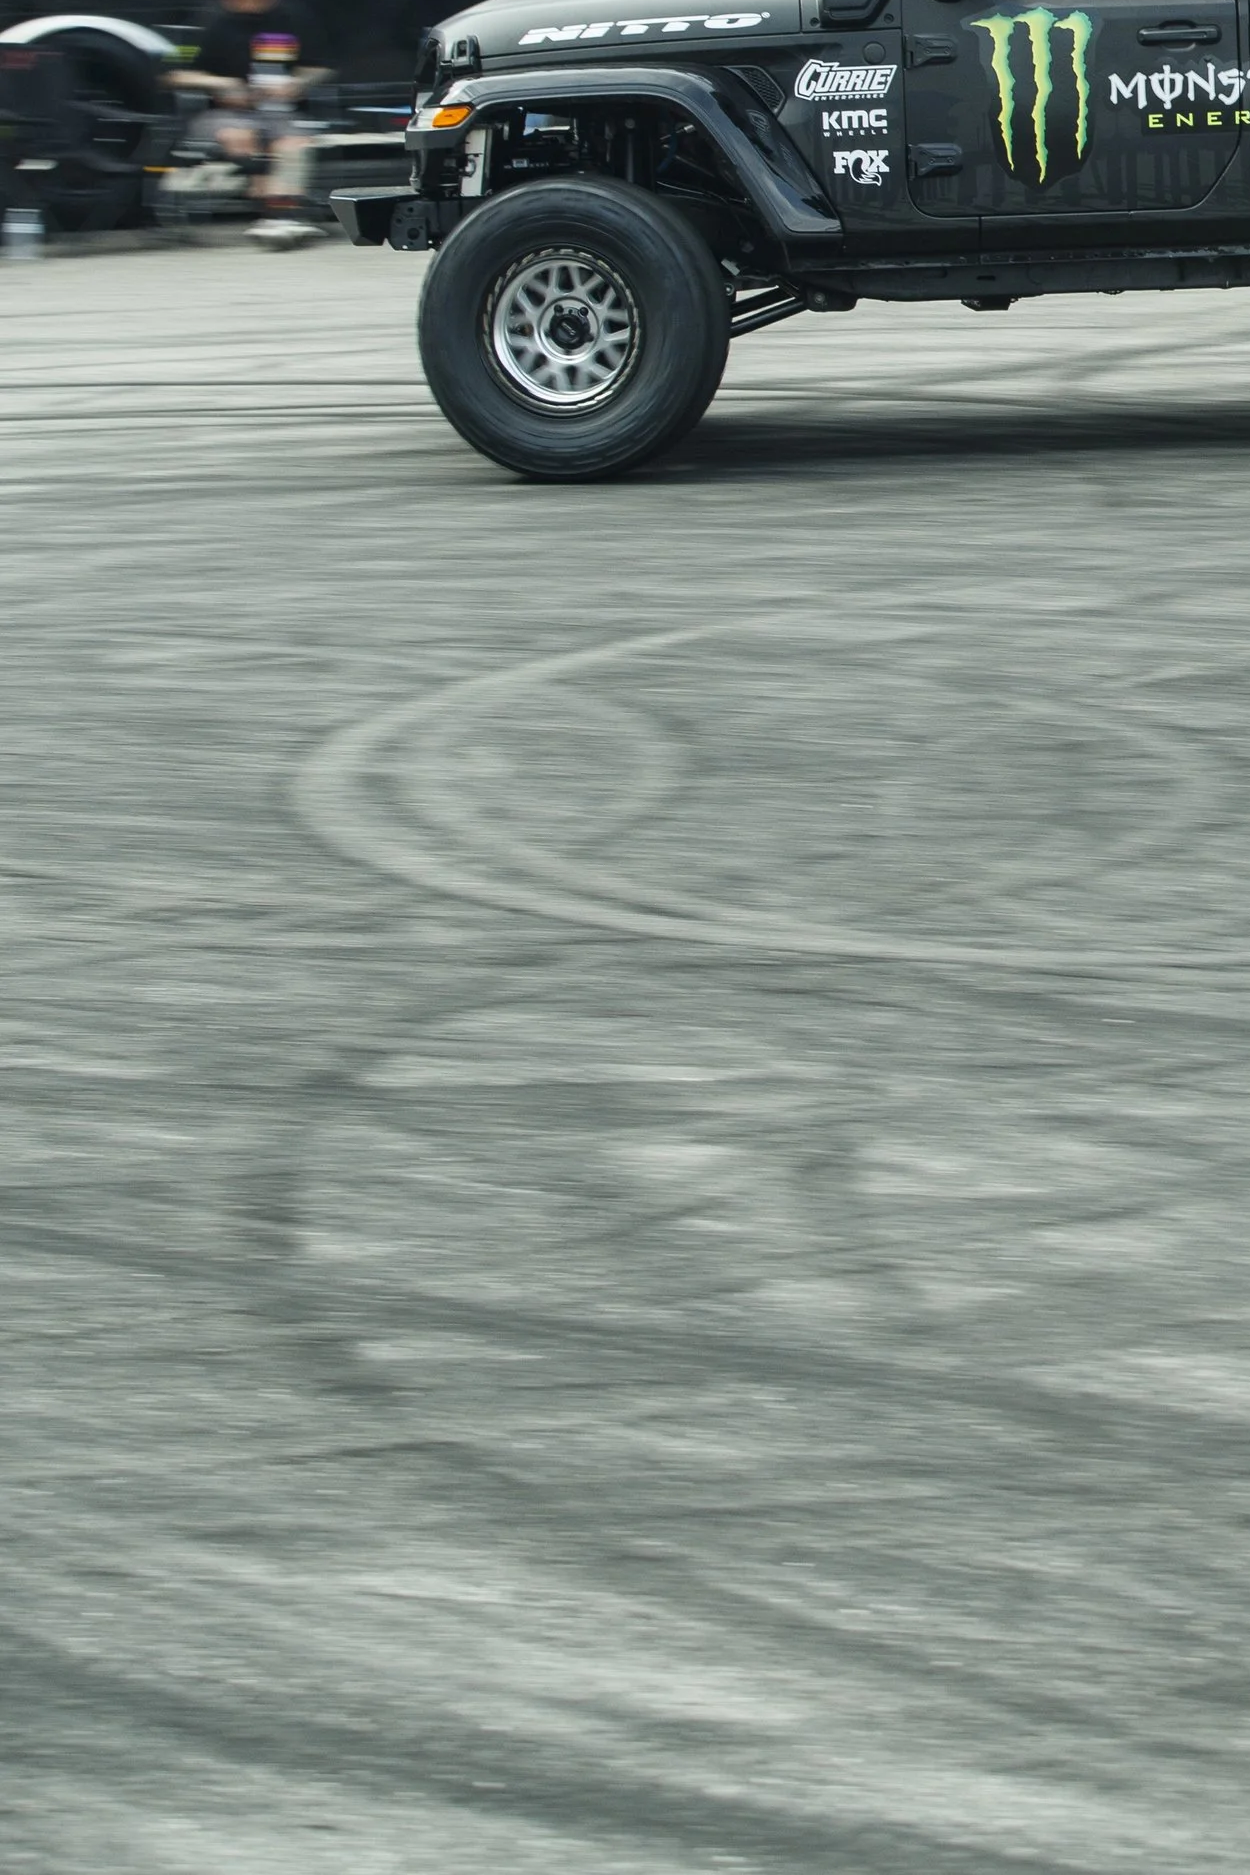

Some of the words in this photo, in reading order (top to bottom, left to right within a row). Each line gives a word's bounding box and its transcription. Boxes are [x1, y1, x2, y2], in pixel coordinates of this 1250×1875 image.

[518, 12, 763, 45] NITTO
[797, 63, 893, 97] CURRIE
[814, 93, 885, 101] ENTERPRISES
[821, 108, 888, 130] KMC
[823, 129, 888, 137] WHEELS
[832, 149, 890, 186] FOX
